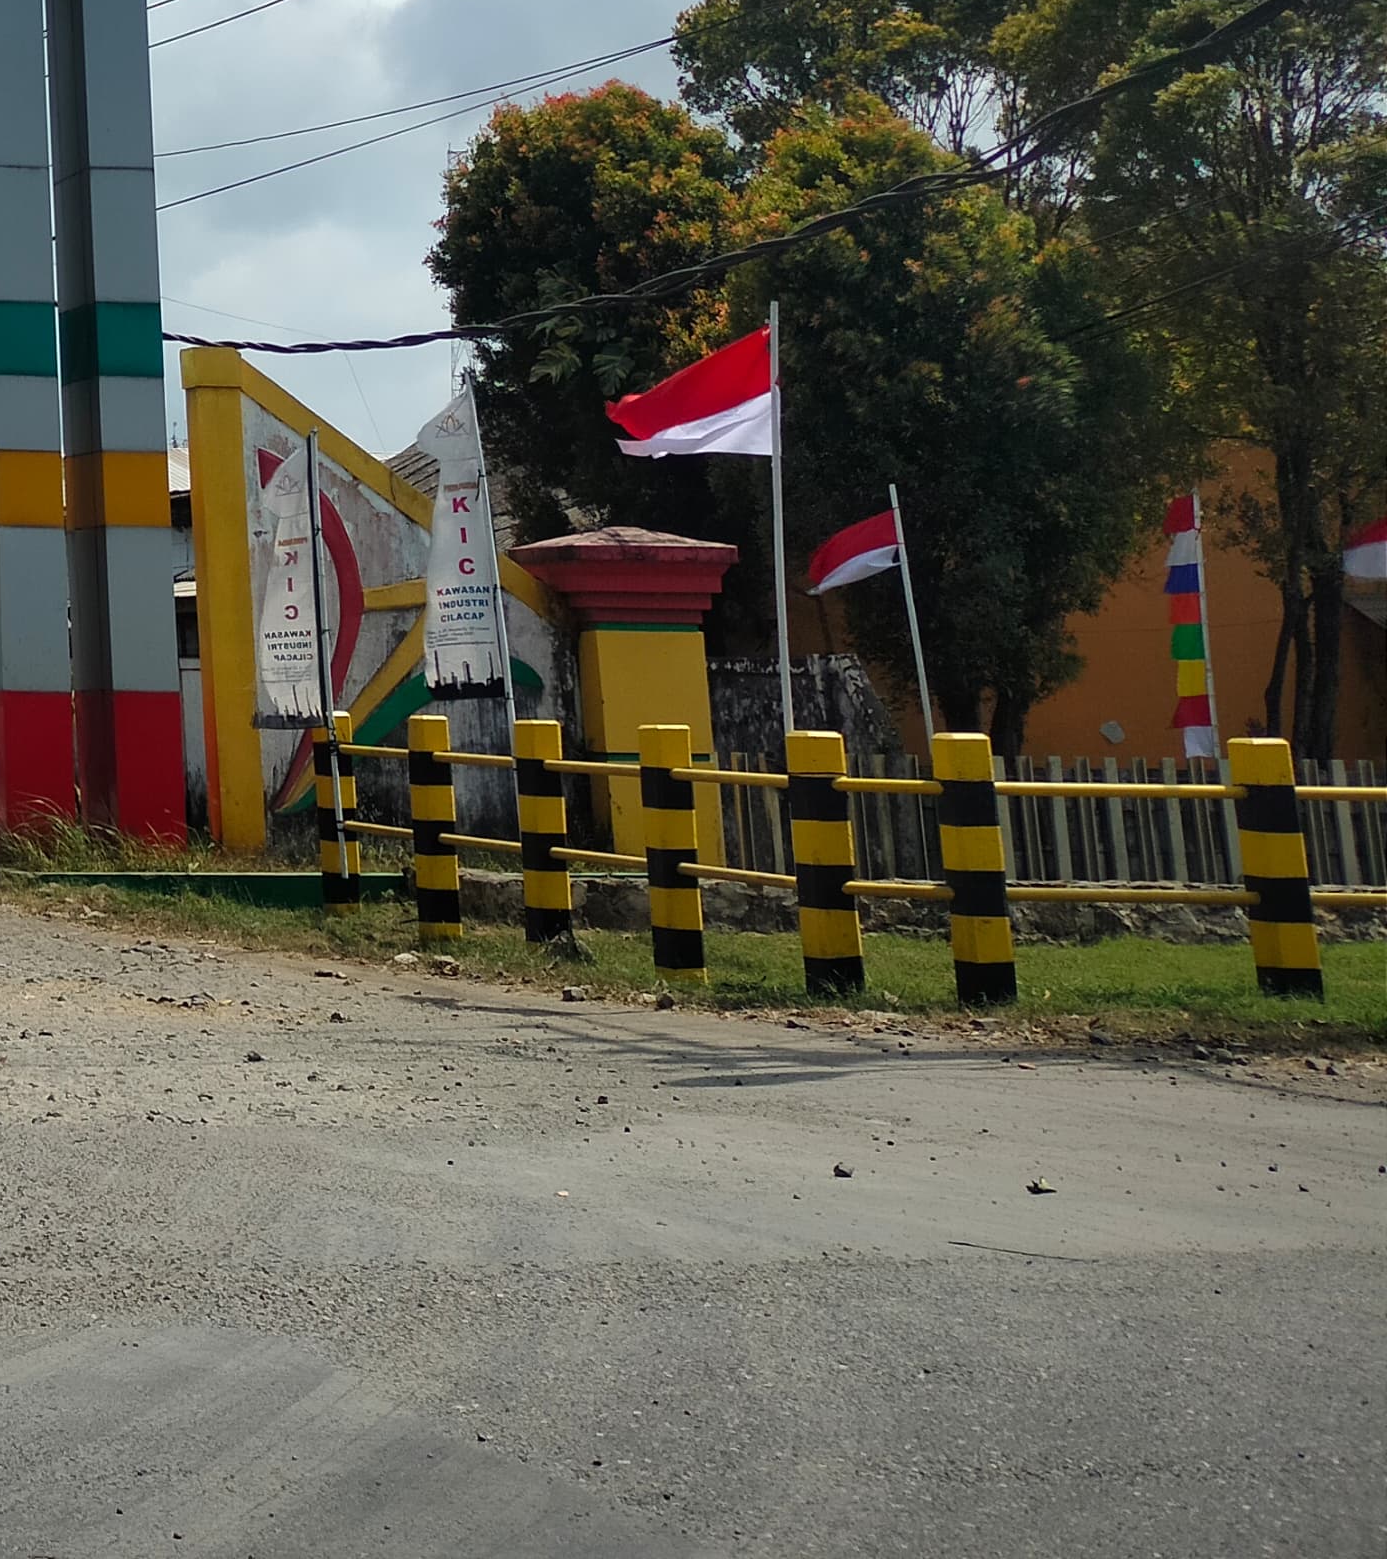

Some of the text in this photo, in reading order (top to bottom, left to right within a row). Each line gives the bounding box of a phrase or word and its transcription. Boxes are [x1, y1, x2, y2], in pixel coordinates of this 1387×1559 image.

[437, 585, 491, 597] KAWASAN
[439, 597, 489, 610] INDUSTRI
[440, 611, 485, 623] CILACAP
